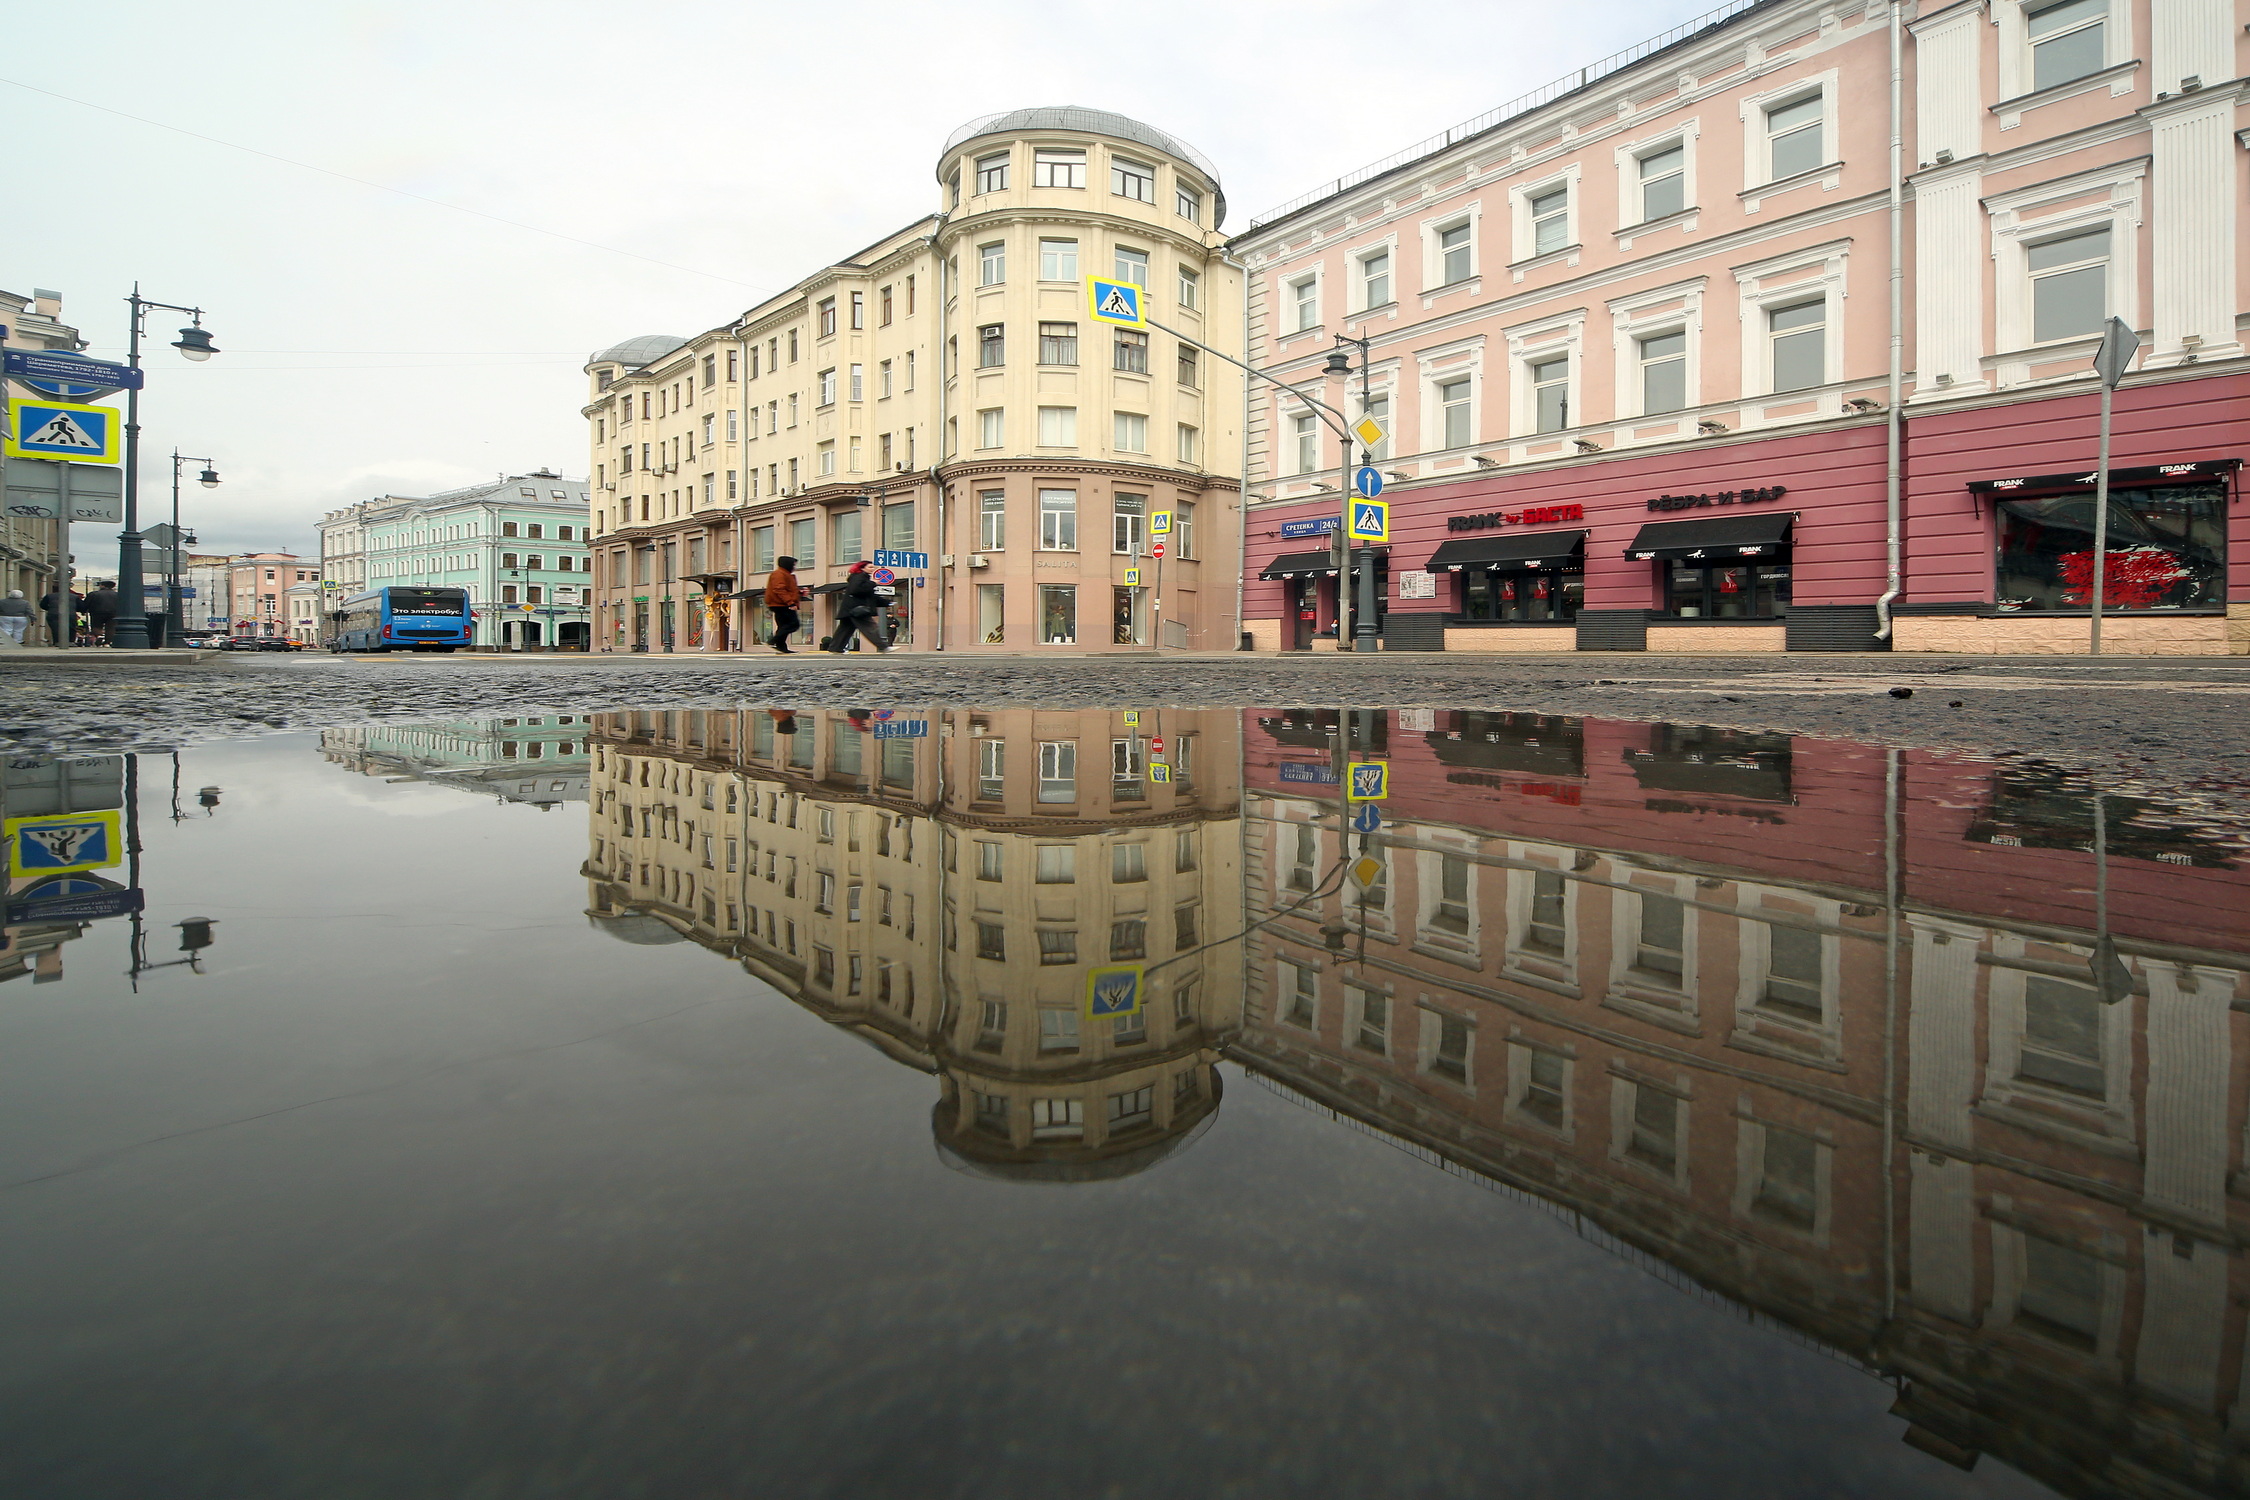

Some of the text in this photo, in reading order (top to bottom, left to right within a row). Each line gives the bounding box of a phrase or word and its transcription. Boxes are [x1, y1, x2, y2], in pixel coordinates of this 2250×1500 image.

[2160, 463, 2196, 474] FRANK
[1993, 478, 2025, 488] FRANK
[1647, 486, 1787, 511] РЁБРА И БАР
[1523, 504, 1584, 524] БАСТА
[1286, 522, 1314, 531] СРЕТЕНКА
[1322, 520, 1338, 530] 24/2
[1448, 512, 1520, 531] FRANK by
[1037, 560, 1077, 568] SALITA
[410, 608, 463, 616] электробус.
